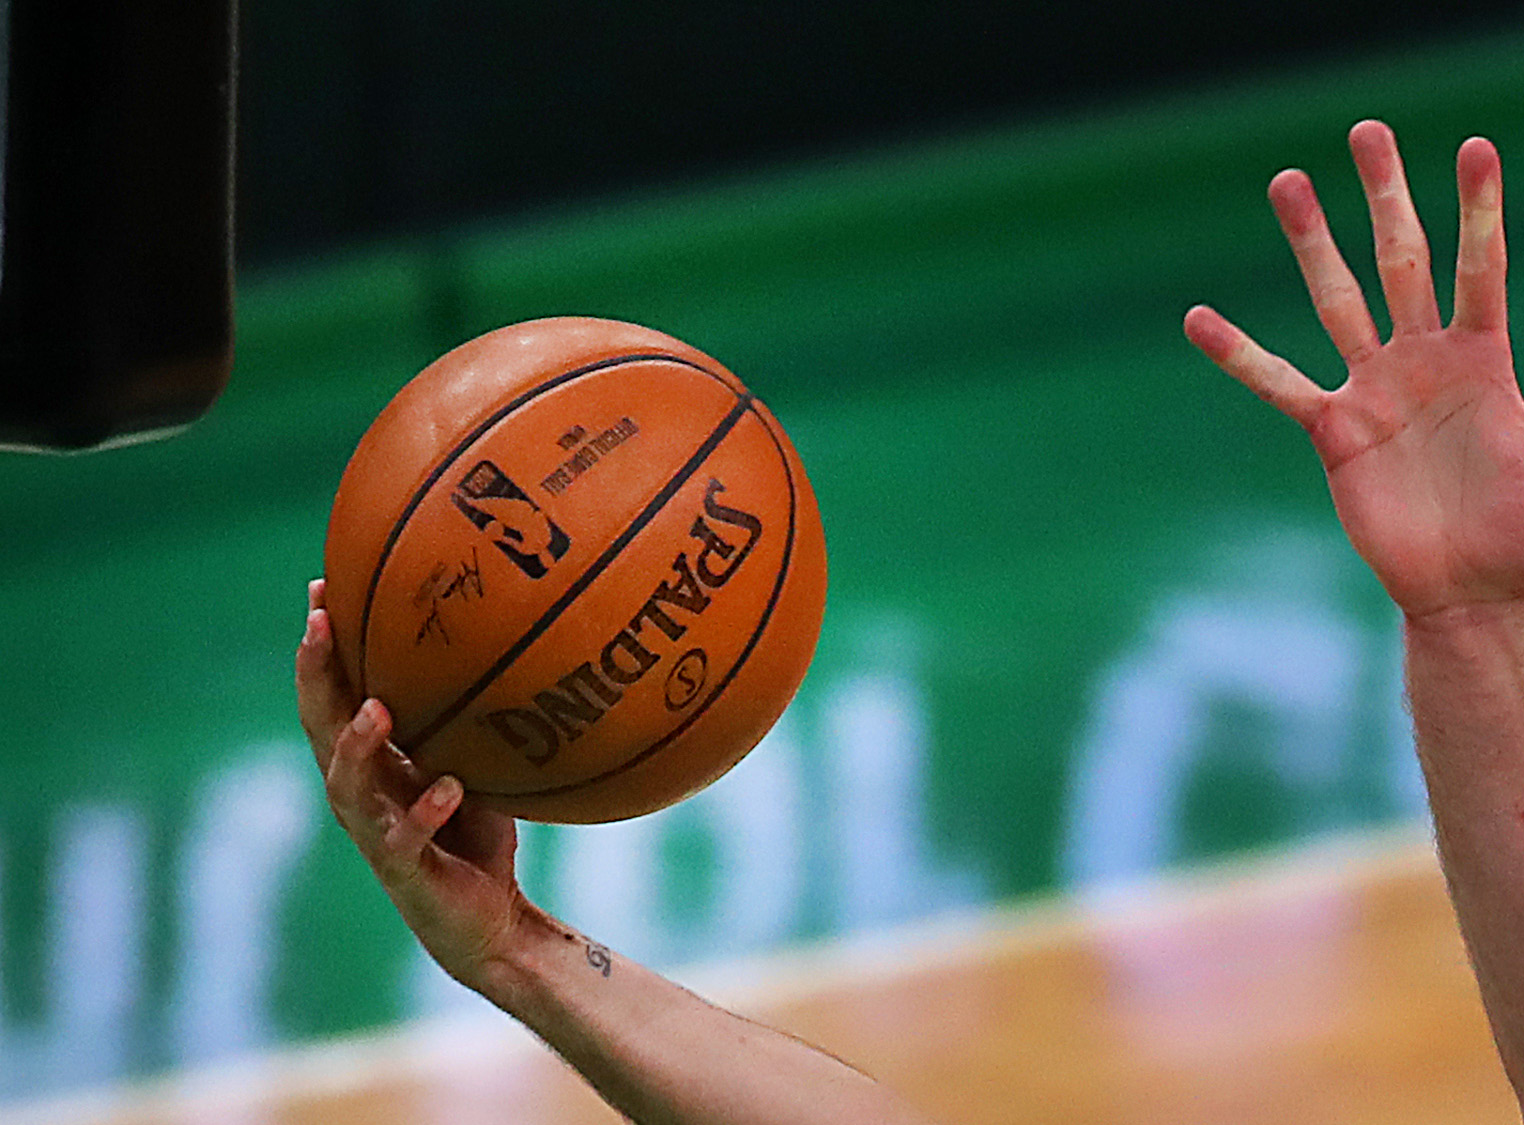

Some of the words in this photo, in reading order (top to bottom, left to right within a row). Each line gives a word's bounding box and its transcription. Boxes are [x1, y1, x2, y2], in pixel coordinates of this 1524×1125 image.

[588, 416, 639, 455] OFFICIAL
[563, 445, 599, 477] GAME
[540, 468, 573, 498] BALL
[477, 477, 762, 769] SPALDING
